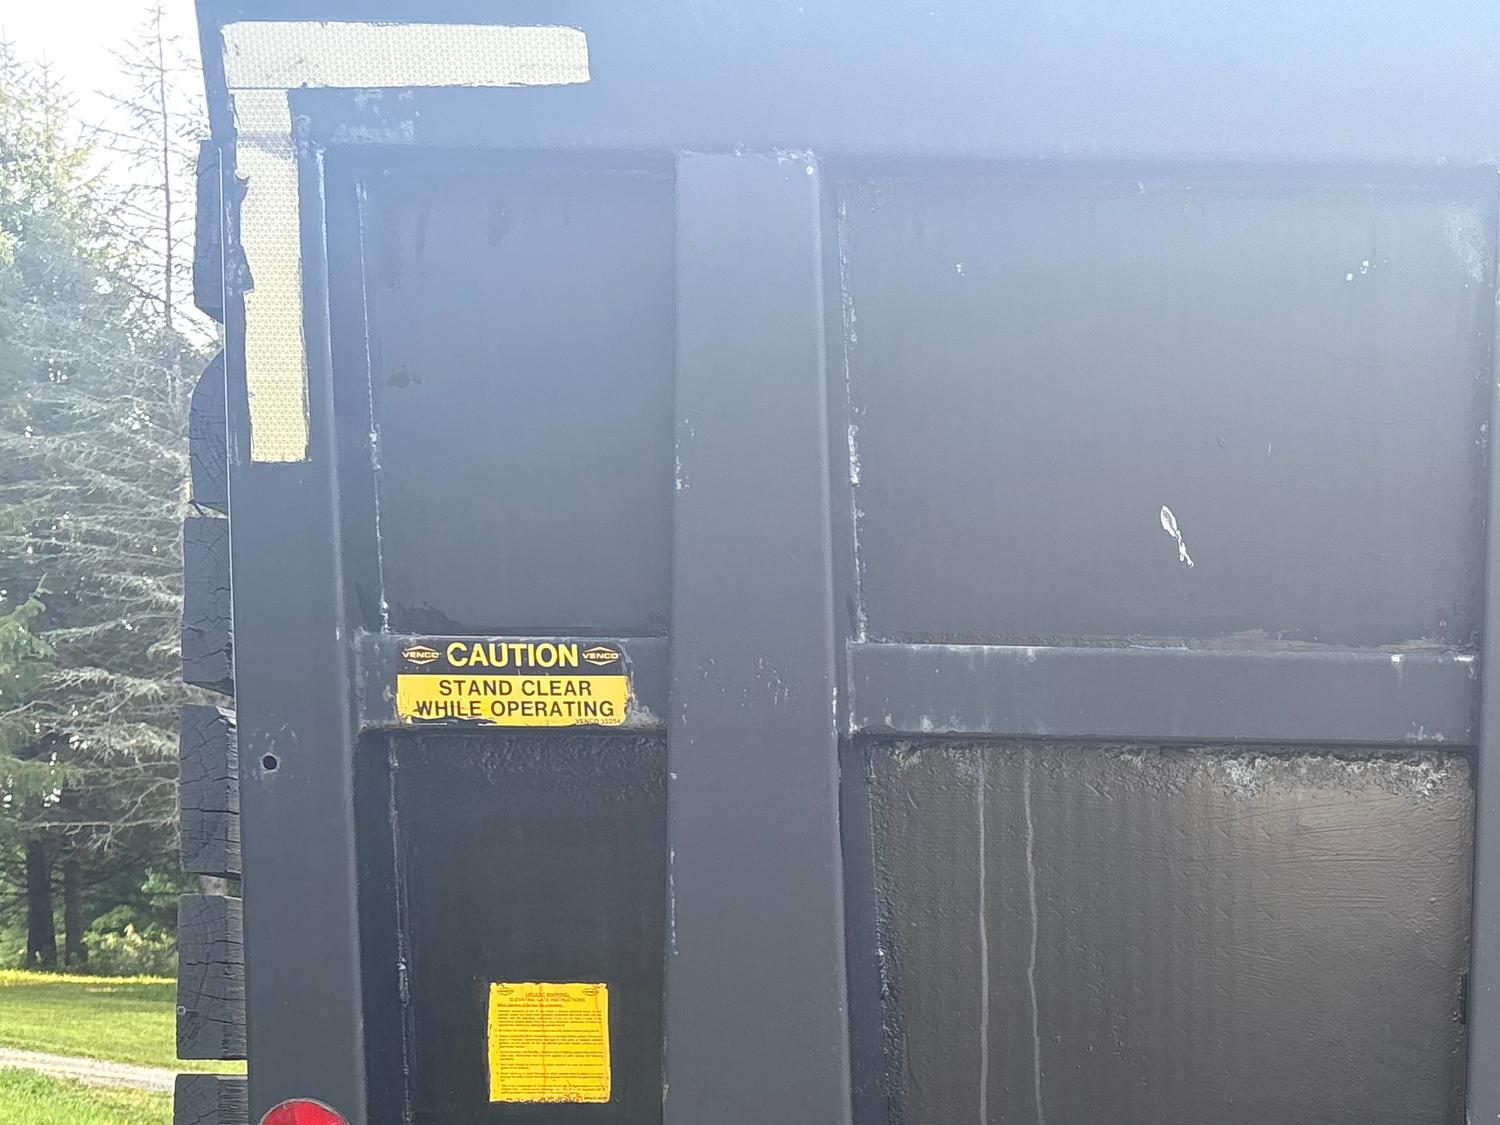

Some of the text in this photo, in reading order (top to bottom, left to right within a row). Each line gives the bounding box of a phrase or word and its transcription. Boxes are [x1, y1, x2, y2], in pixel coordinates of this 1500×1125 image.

[401, 651, 440, 659] VENCO
[446, 642, 579, 668] CAUTION
[581, 652, 619, 660] VENCO
[439, 680, 592, 697] STAND CLEAR
[415, 700, 614, 717] WHILE OPERATING
